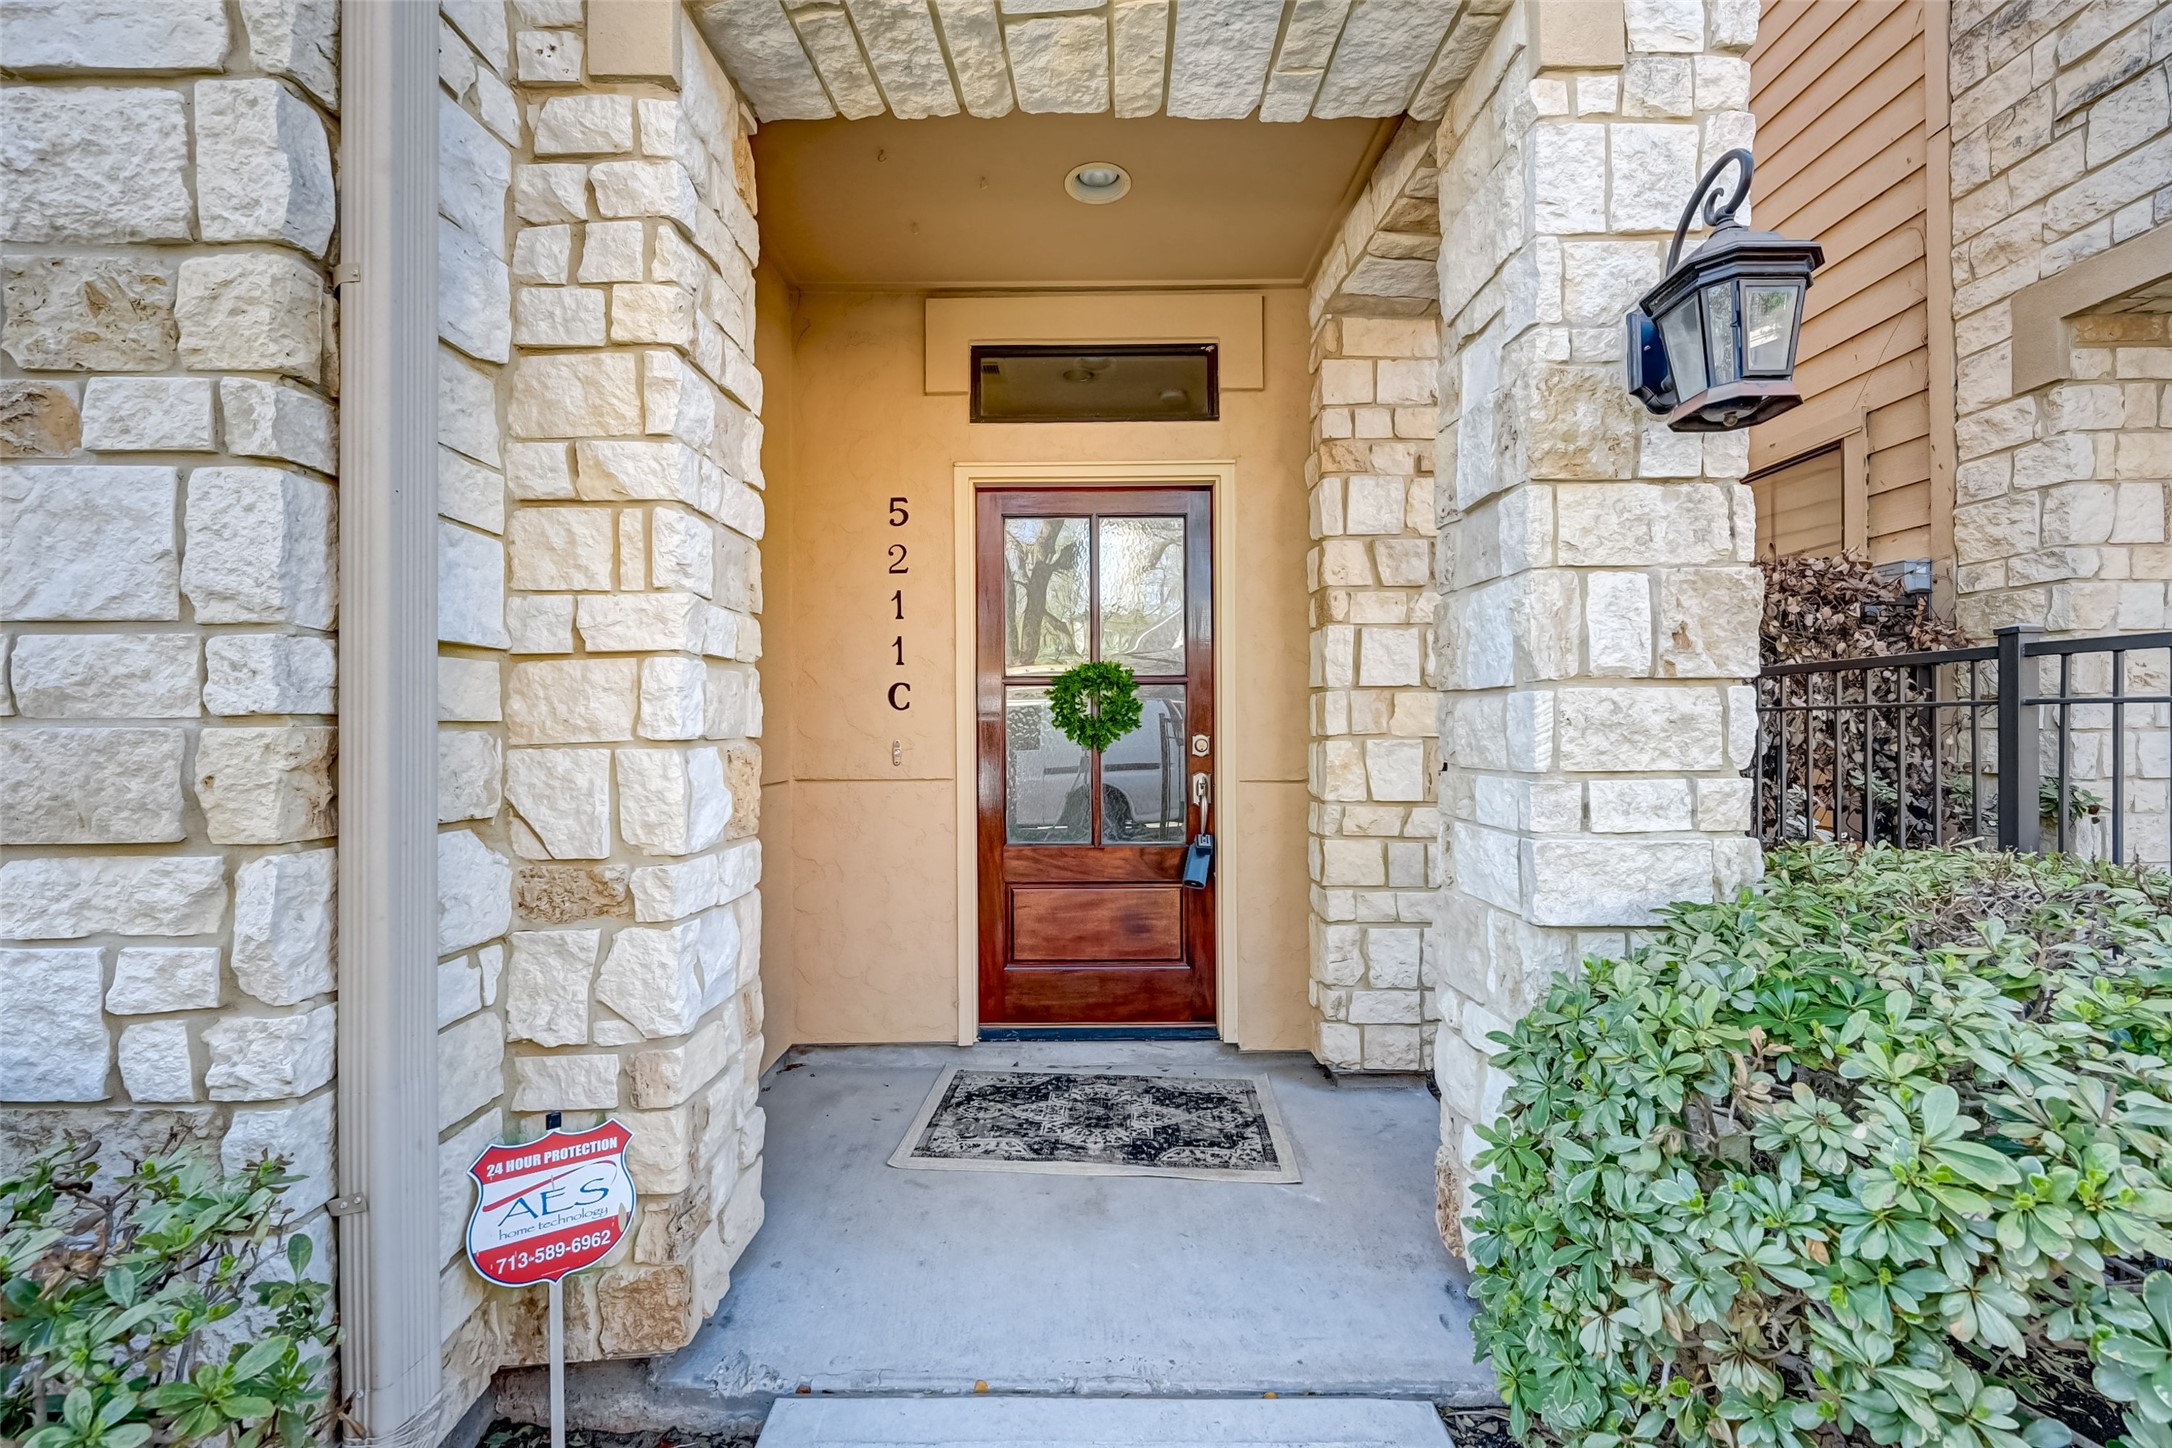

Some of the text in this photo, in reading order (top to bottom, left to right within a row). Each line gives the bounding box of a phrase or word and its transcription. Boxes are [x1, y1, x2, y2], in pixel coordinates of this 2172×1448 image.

[486, 1136, 618, 1177] 24 HOUR PROTECTION
[497, 1177, 609, 1226] AES
[498, 1207, 608, 1240] home technology
[496, 1229, 611, 1274] 713-589-6962
